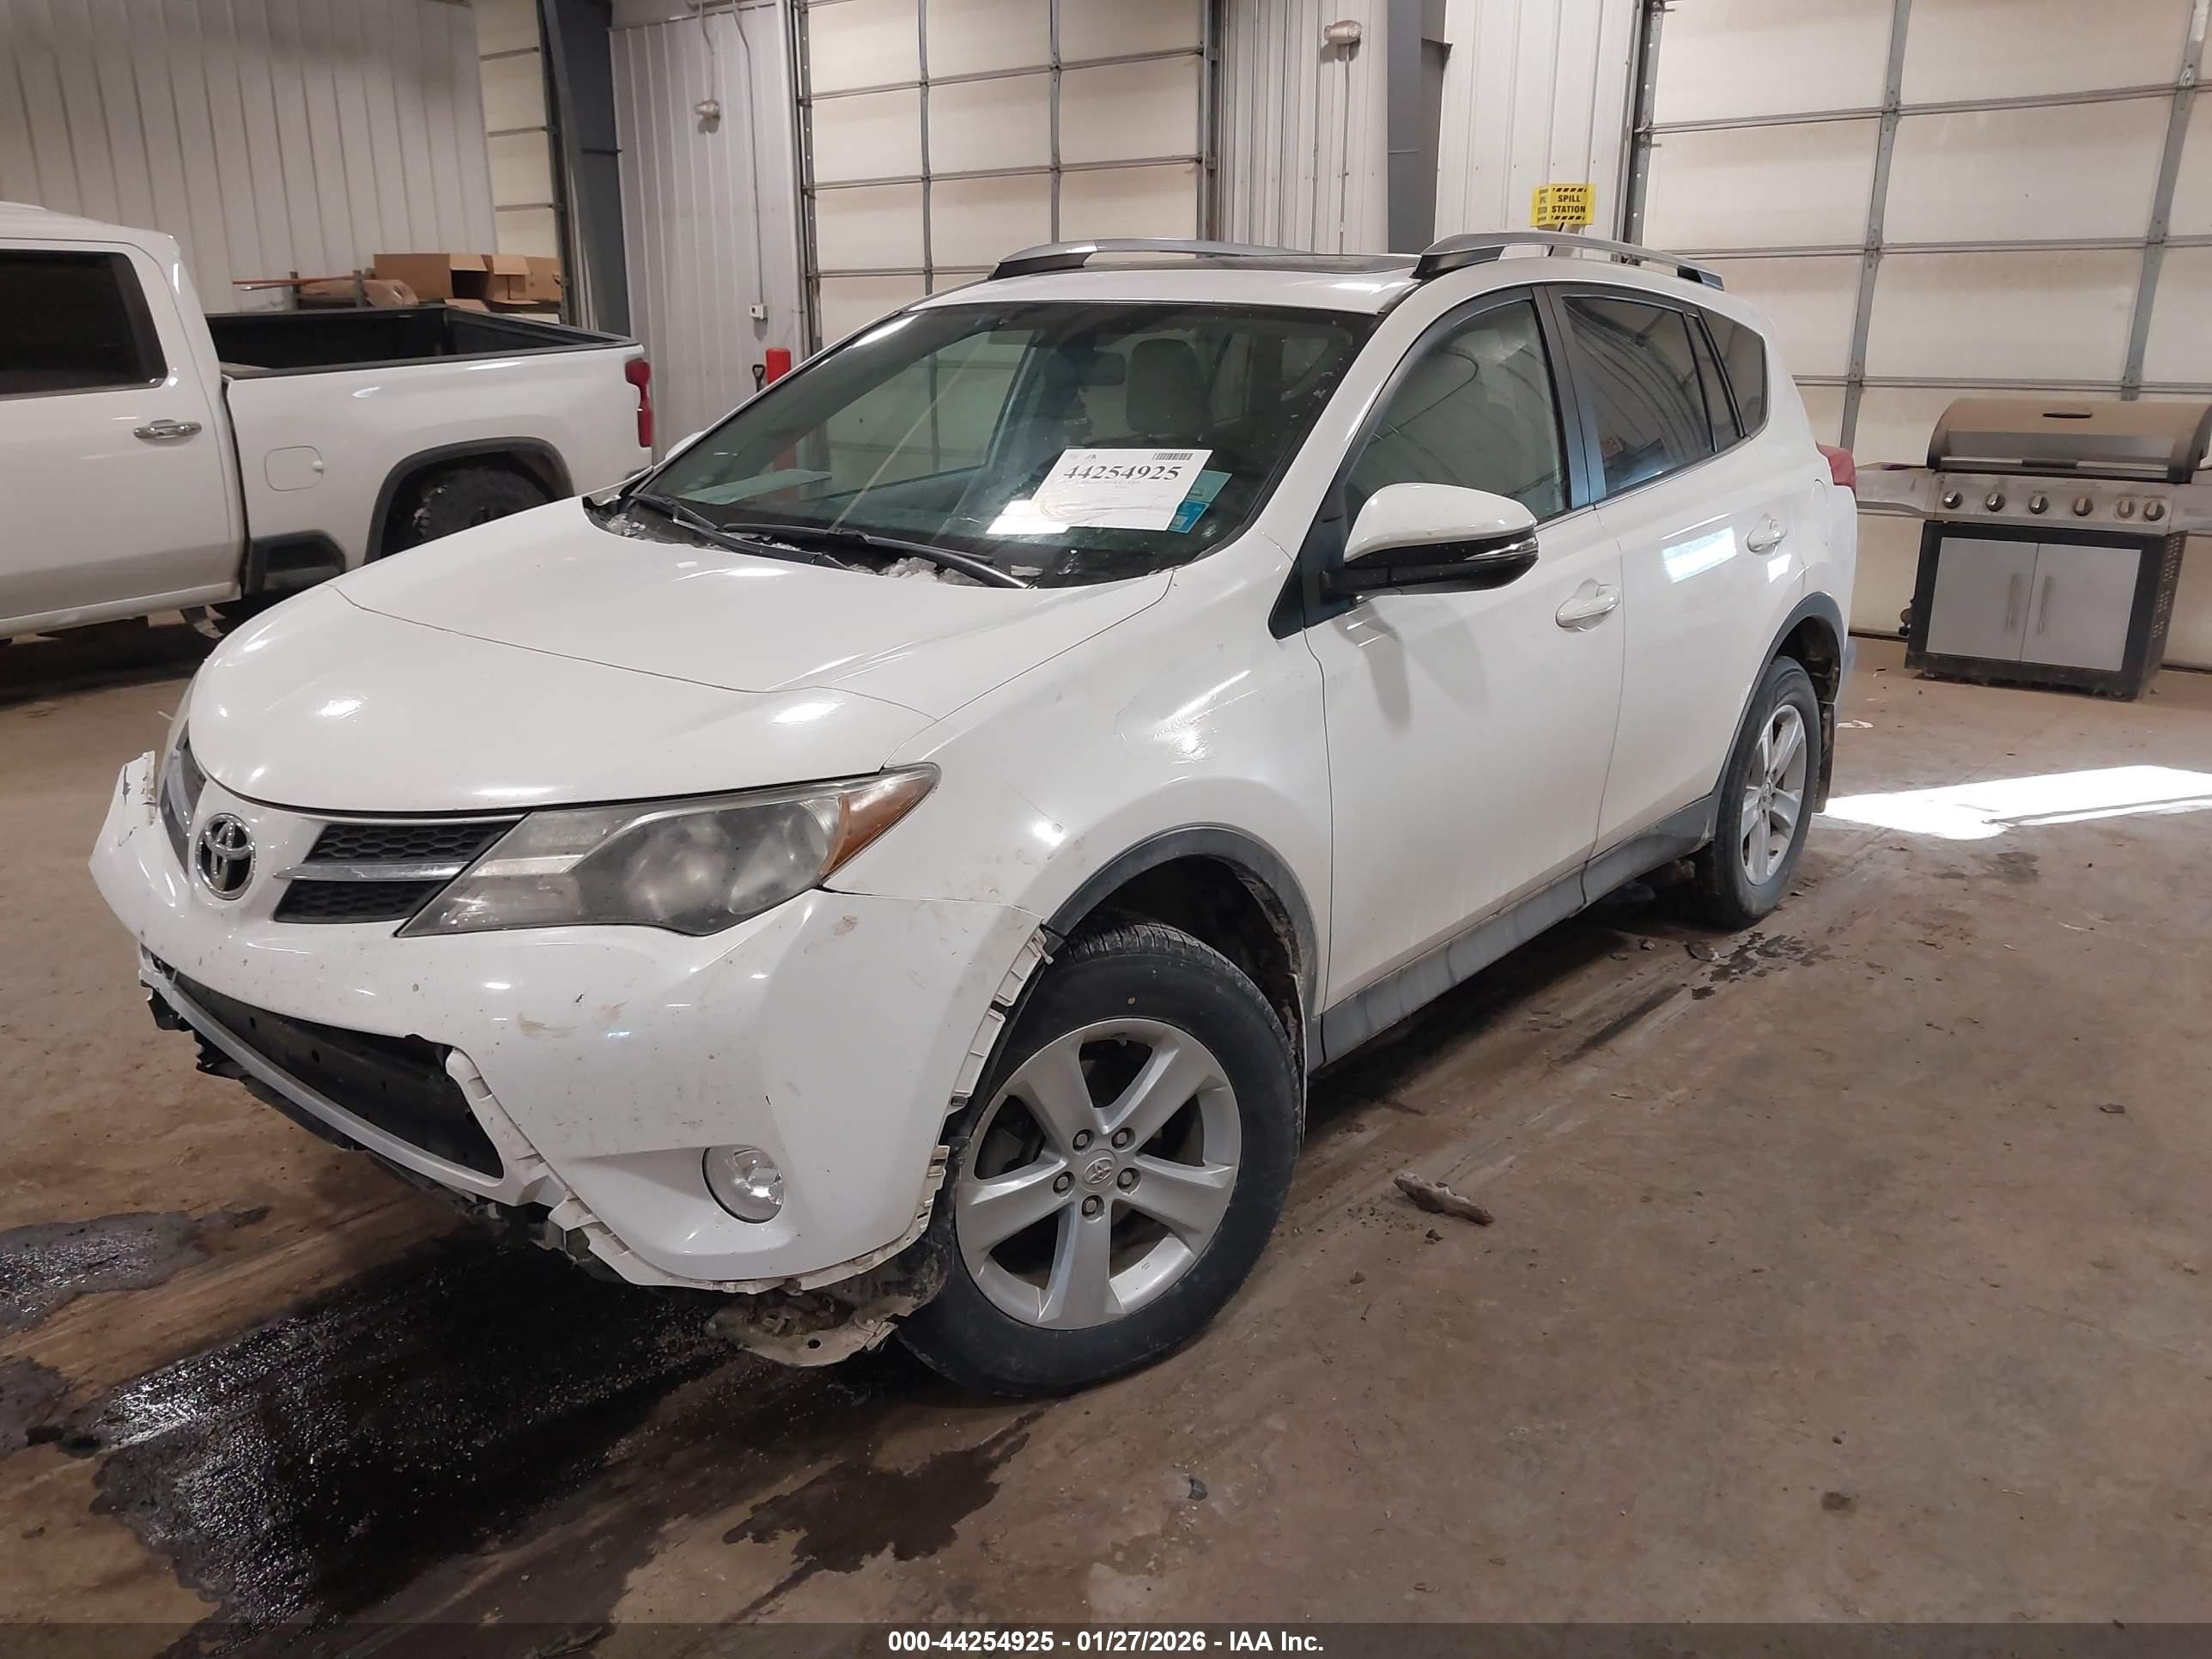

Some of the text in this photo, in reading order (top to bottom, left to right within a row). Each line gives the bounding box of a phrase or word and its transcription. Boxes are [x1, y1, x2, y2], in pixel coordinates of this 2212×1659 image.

[1558, 194, 1581, 203] SPILL
[1551, 205, 1586, 214] STATION
[1063, 465, 1182, 481] 44254925
